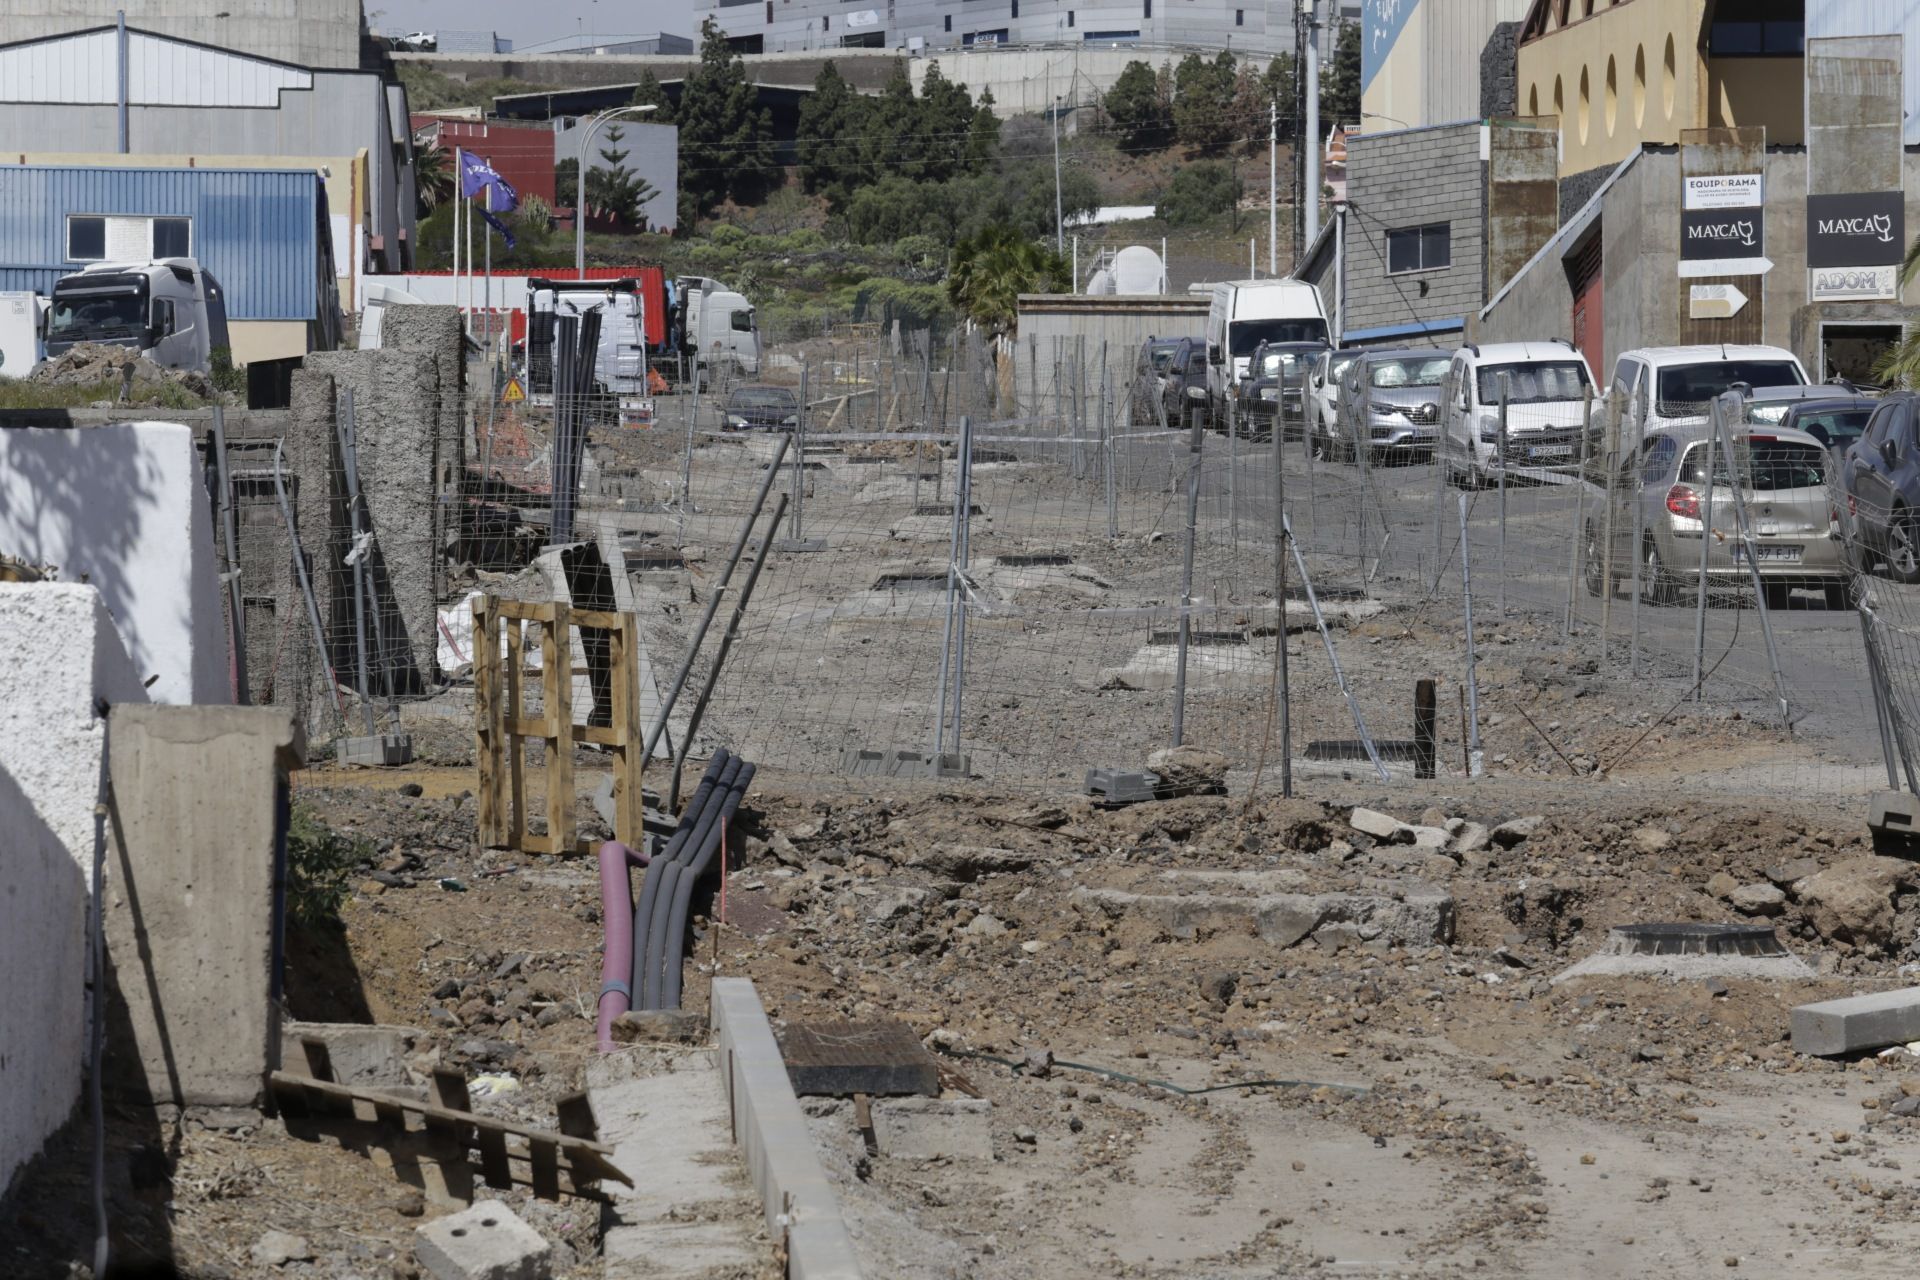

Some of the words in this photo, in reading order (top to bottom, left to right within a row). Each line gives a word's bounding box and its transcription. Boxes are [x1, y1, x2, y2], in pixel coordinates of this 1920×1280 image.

[1690, 178, 1757, 189] EQUIPORAMA
[1688, 224, 1740, 239] MAYCA
[1818, 218, 1876, 234] MAYCA
[1816, 272, 1876, 290] ADOM
